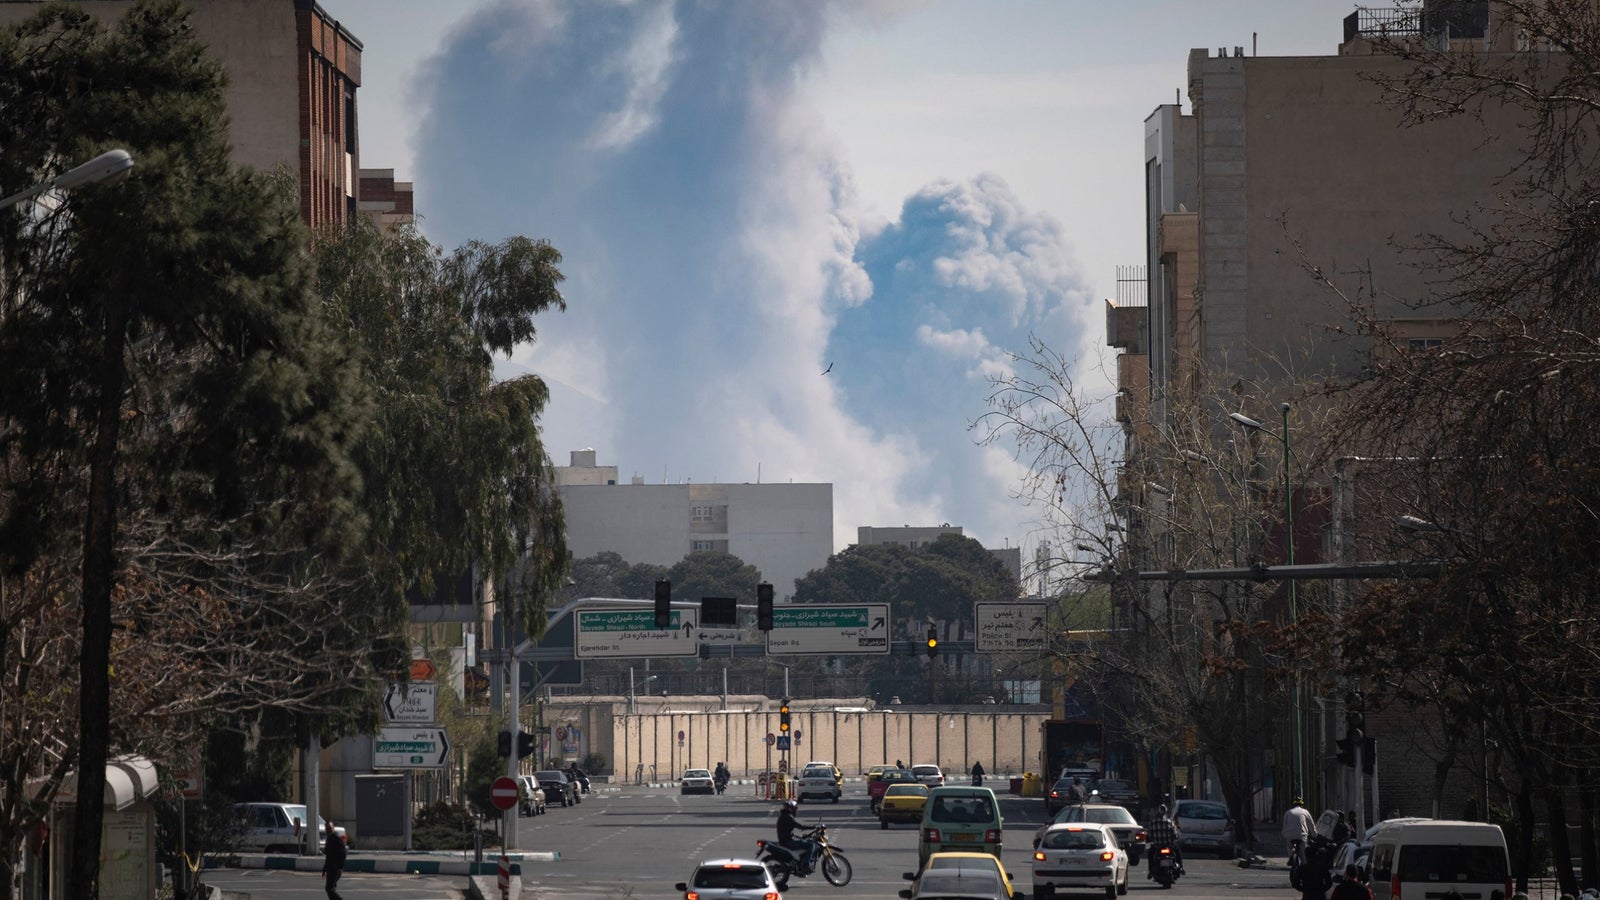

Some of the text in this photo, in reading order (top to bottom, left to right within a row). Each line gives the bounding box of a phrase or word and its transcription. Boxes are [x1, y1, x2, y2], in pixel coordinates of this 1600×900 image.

[581, 614, 601, 623] شمال
[607, 614, 633, 624] شیرازی
[796, 611, 819, 619] شیرازی
[651, 631, 670, 639] شهید
